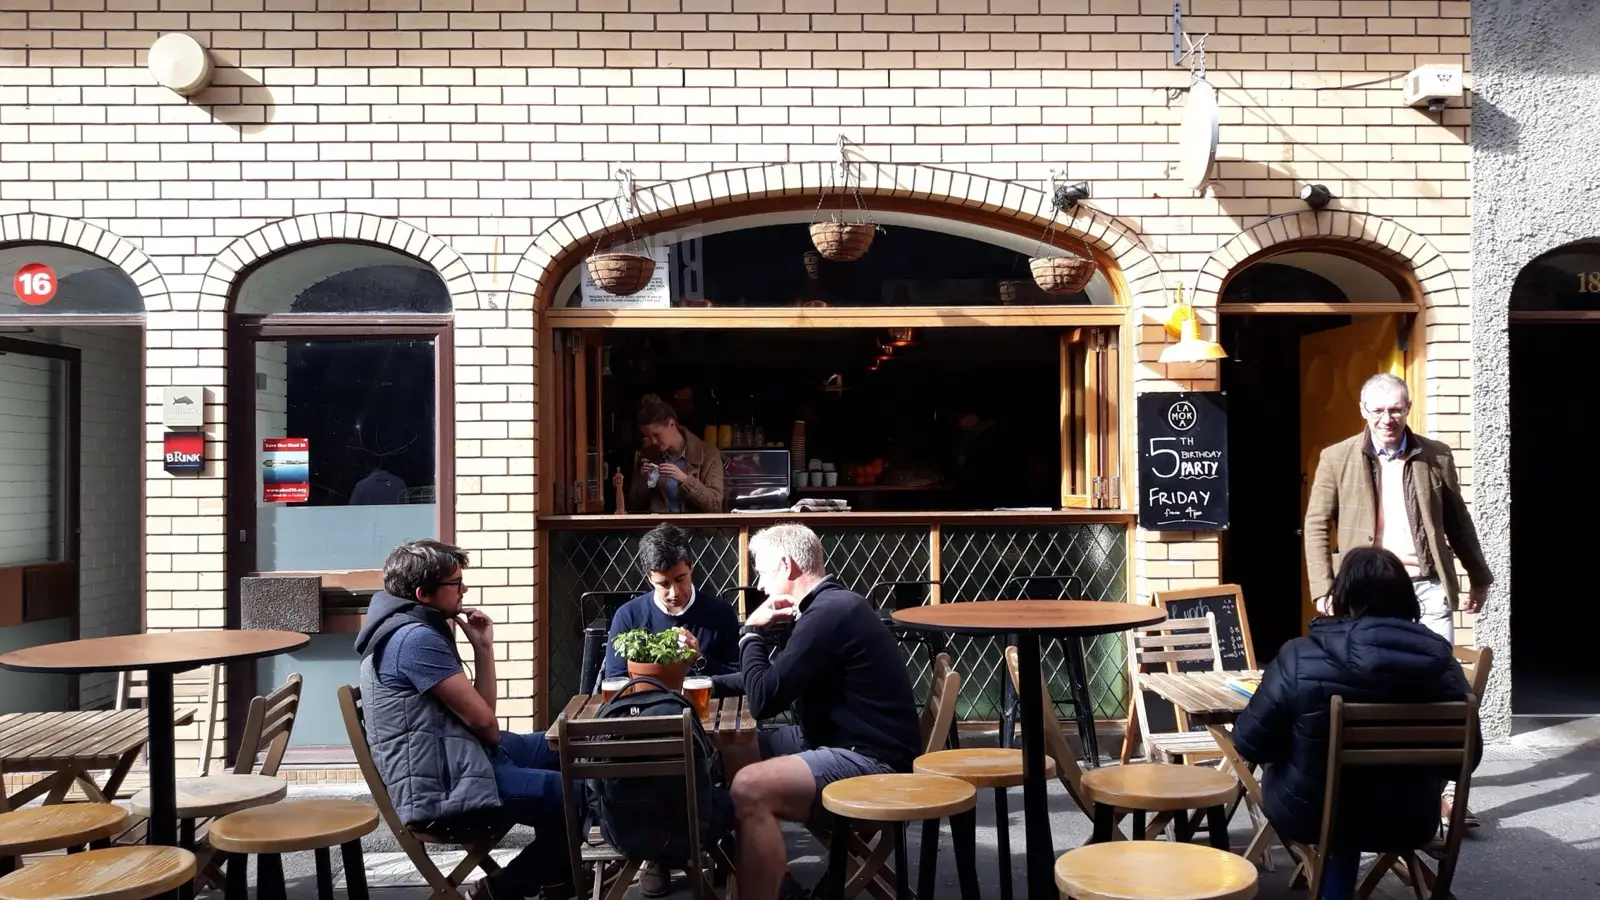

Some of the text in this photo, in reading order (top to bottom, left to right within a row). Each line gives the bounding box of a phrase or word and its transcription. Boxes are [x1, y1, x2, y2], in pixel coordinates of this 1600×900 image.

[19, 272, 51, 295] 16
[1577, 272, 1600, 292] 18
[1181, 451, 1221, 459] BIRTHDAY
[1181, 461, 1218, 476] PARTY
[1149, 487, 1210, 507] FRIDAY
[1164, 506, 1202, 519] from 4pm
